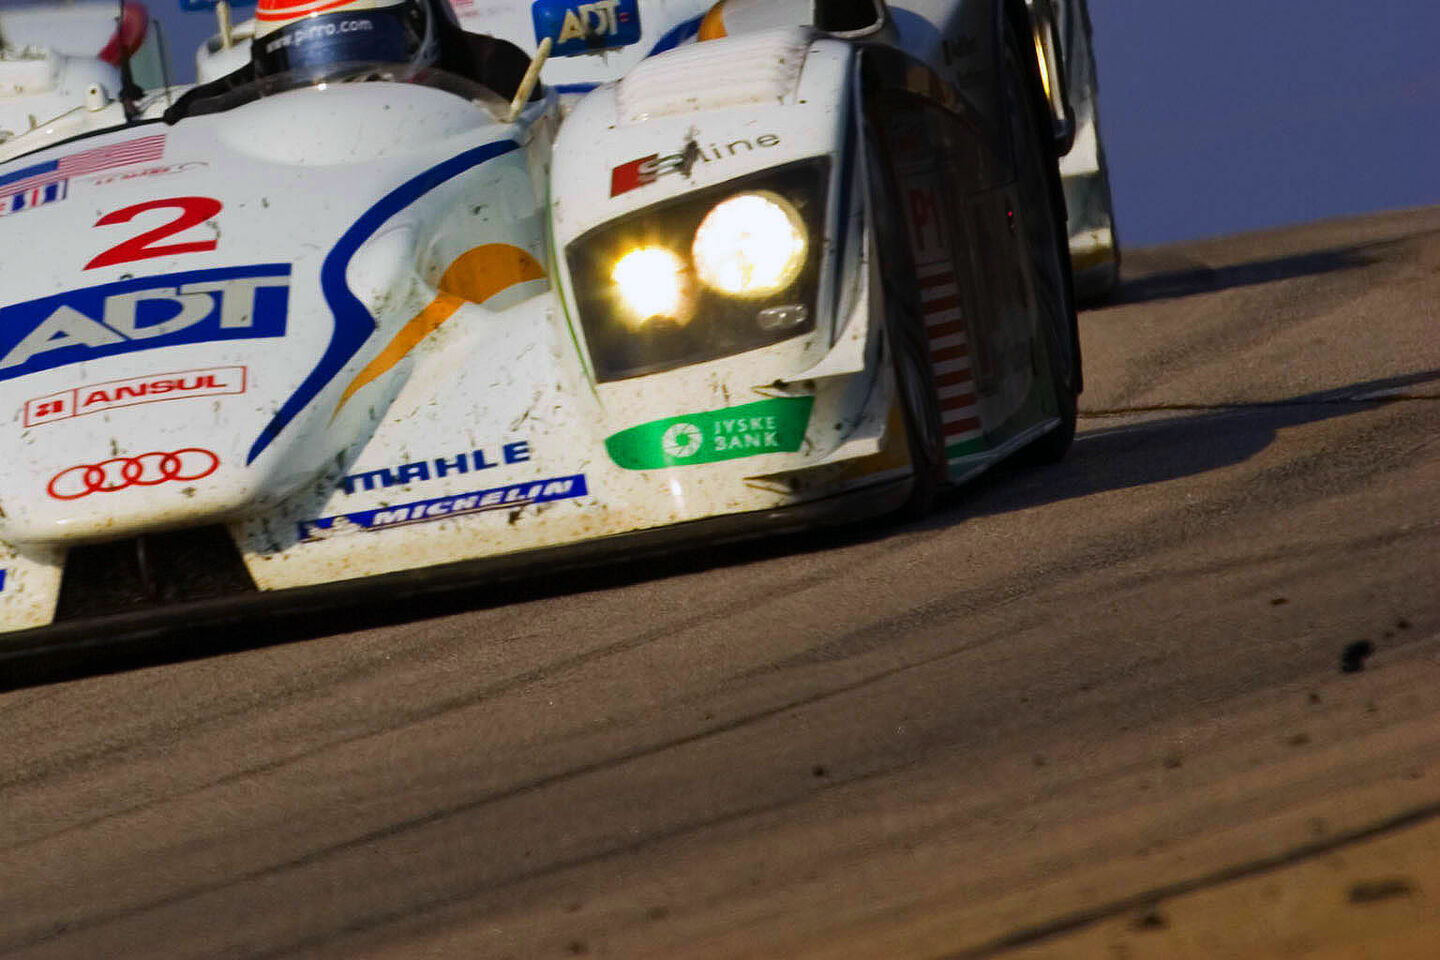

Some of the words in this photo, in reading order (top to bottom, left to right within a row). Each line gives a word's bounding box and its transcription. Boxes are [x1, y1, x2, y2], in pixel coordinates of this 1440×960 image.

[81, 196, 223, 271] 2
[83, 375, 227, 406] ANSUL
[714, 431, 779, 451] BANK
[343, 441, 531, 495] MAHLE
[372, 479, 573, 527] MICHELIN
